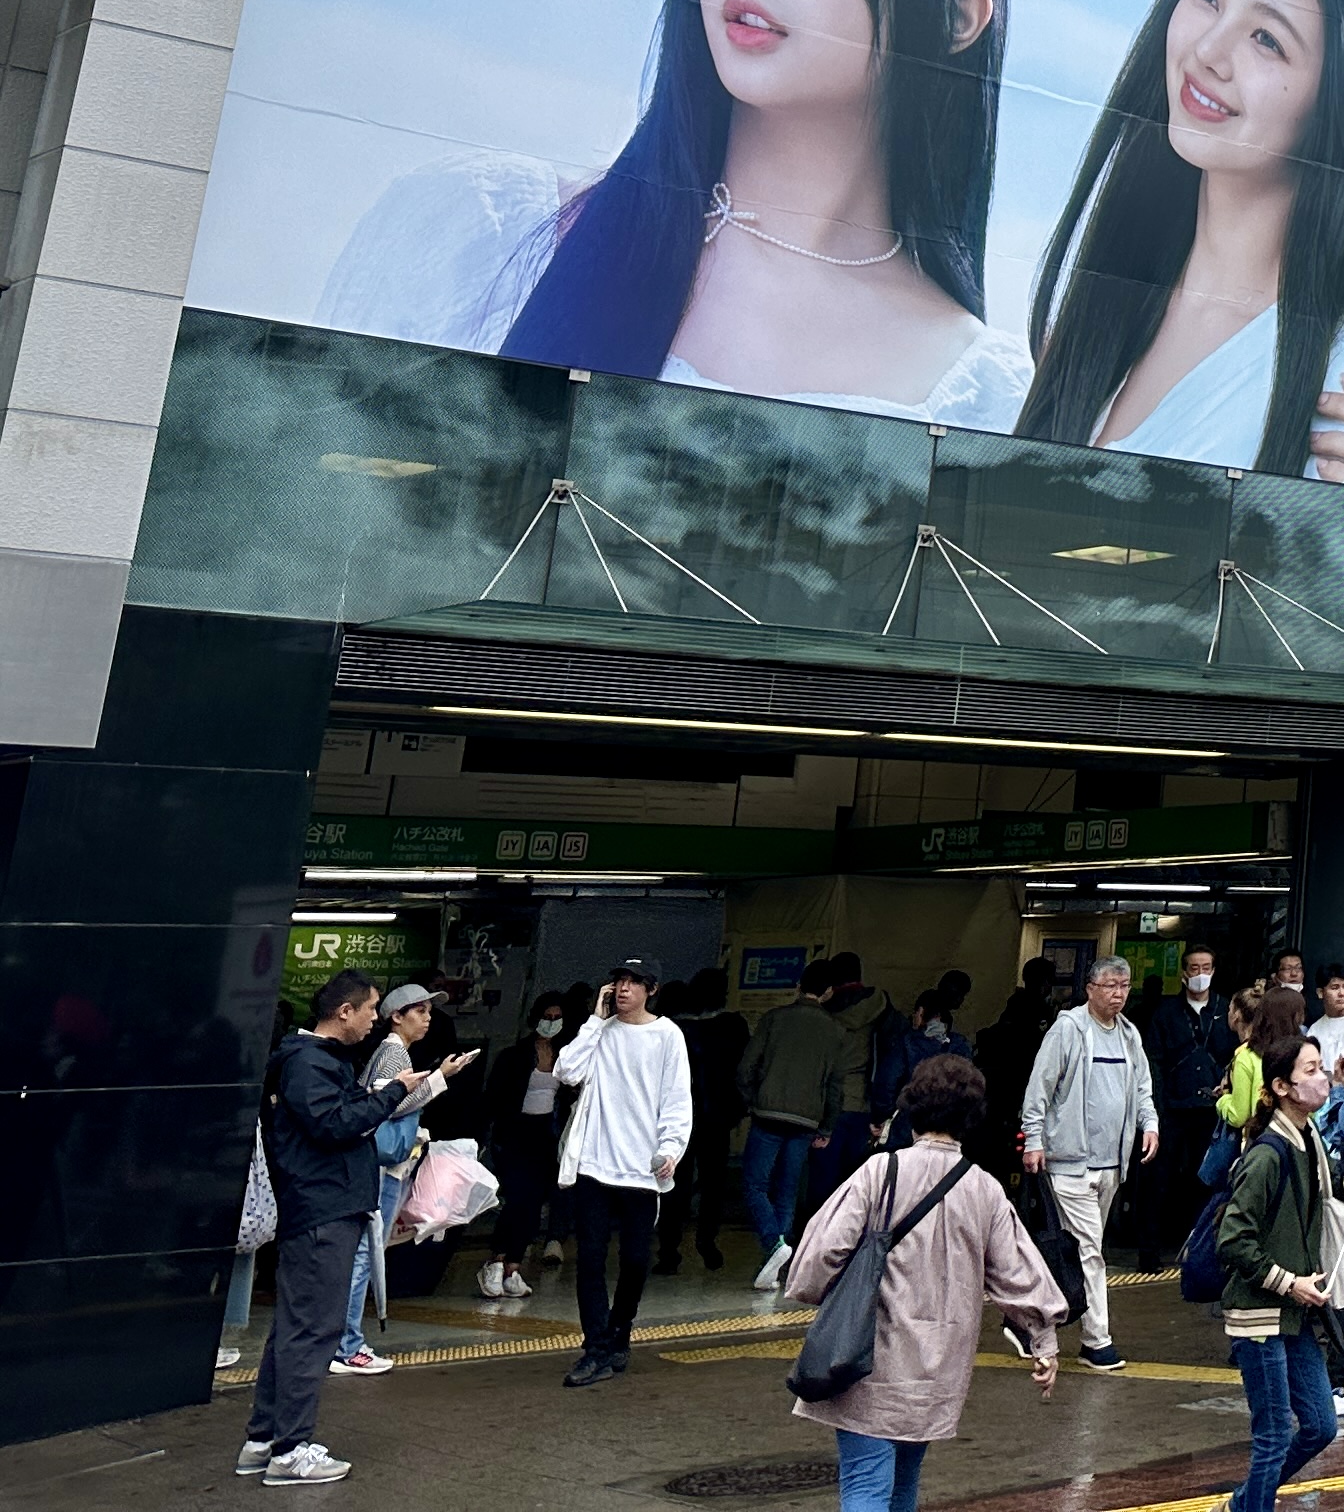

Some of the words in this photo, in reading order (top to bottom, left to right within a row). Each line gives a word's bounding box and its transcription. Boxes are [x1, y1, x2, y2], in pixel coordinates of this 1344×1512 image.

[922, 827, 945, 853] JR
[331, 848, 374, 861] Station
[294, 933, 342, 960] JR
[344, 933, 407, 955] 渋谷駅
[343, 957, 389, 970] Shibuya
[391, 958, 432, 969] Station
